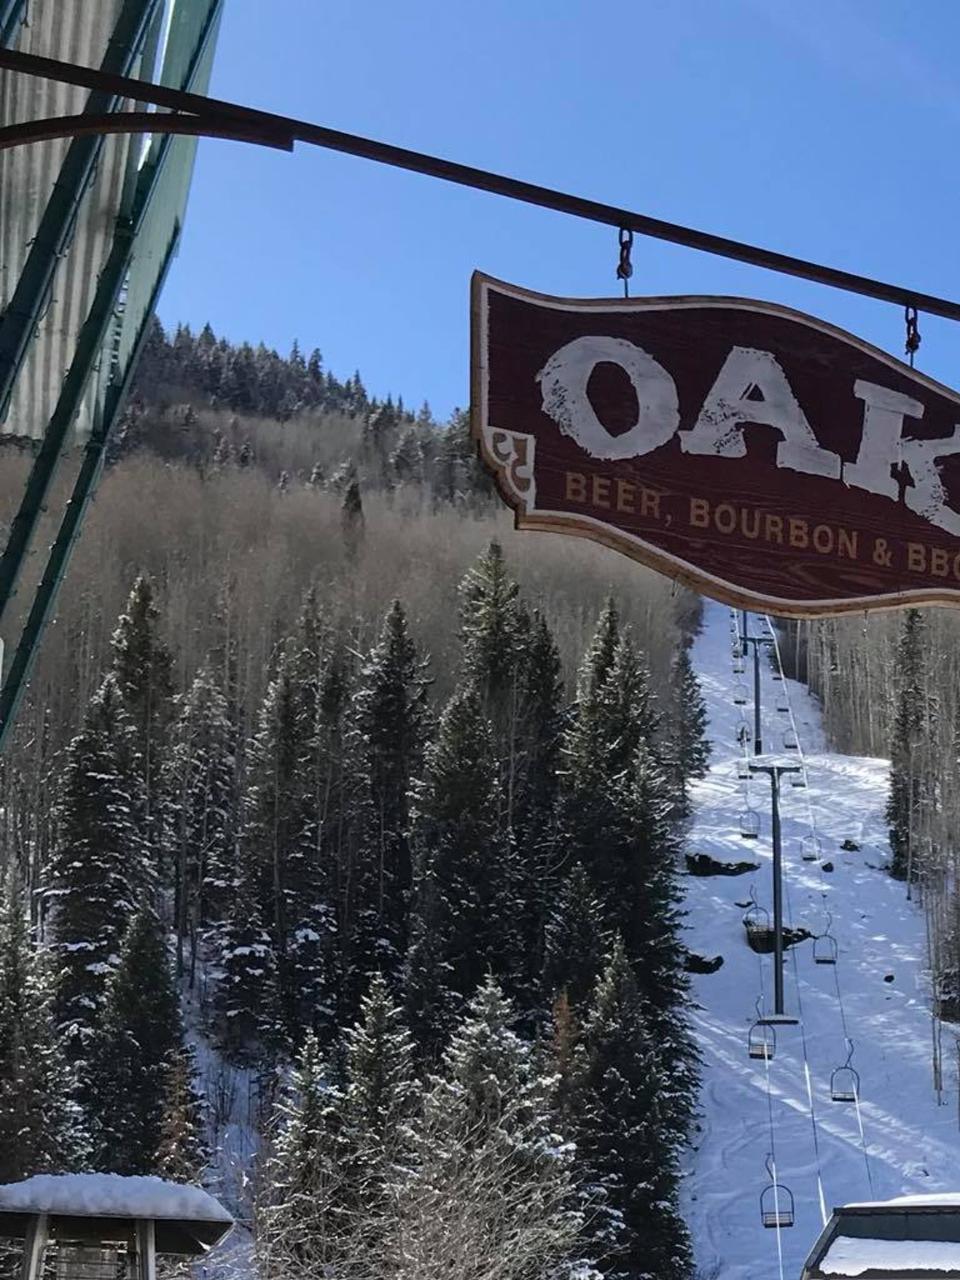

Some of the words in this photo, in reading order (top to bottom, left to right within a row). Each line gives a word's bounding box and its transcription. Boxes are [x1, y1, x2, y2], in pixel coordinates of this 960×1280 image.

[565, 471, 673, 527] BEER,
[689, 497, 859, 560] BOURBON
[872, 537, 894, 568] &
